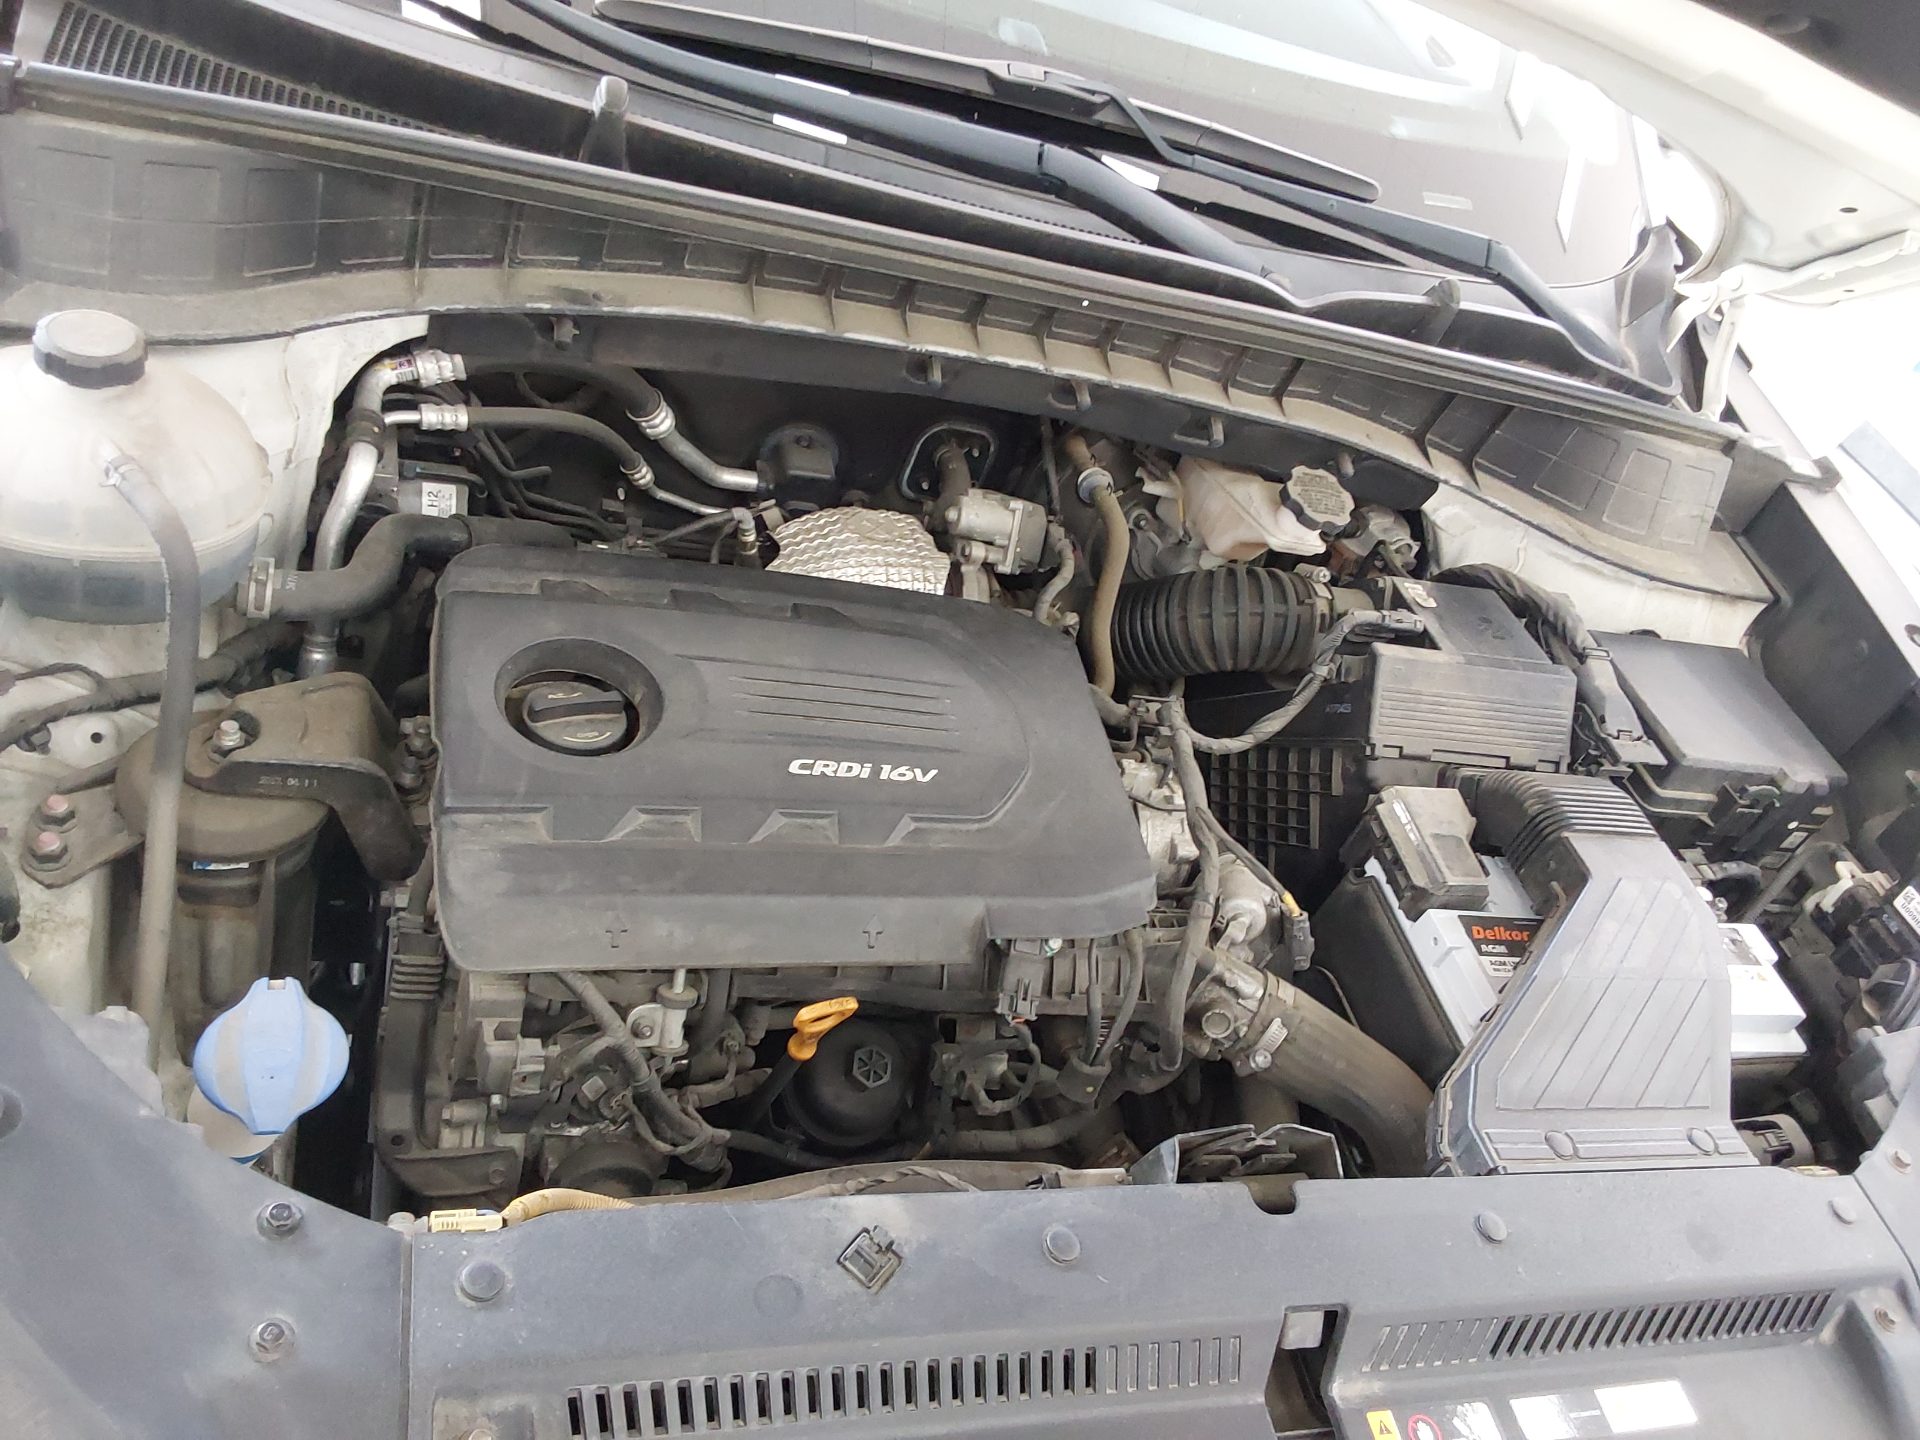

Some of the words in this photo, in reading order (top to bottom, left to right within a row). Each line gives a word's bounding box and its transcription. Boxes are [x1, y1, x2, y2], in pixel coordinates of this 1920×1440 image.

[427, 491, 439, 508] H2
[788, 758, 873, 779] CRDi
[879, 764, 939, 783] 16V
[1471, 925, 1530, 941] Delkor
